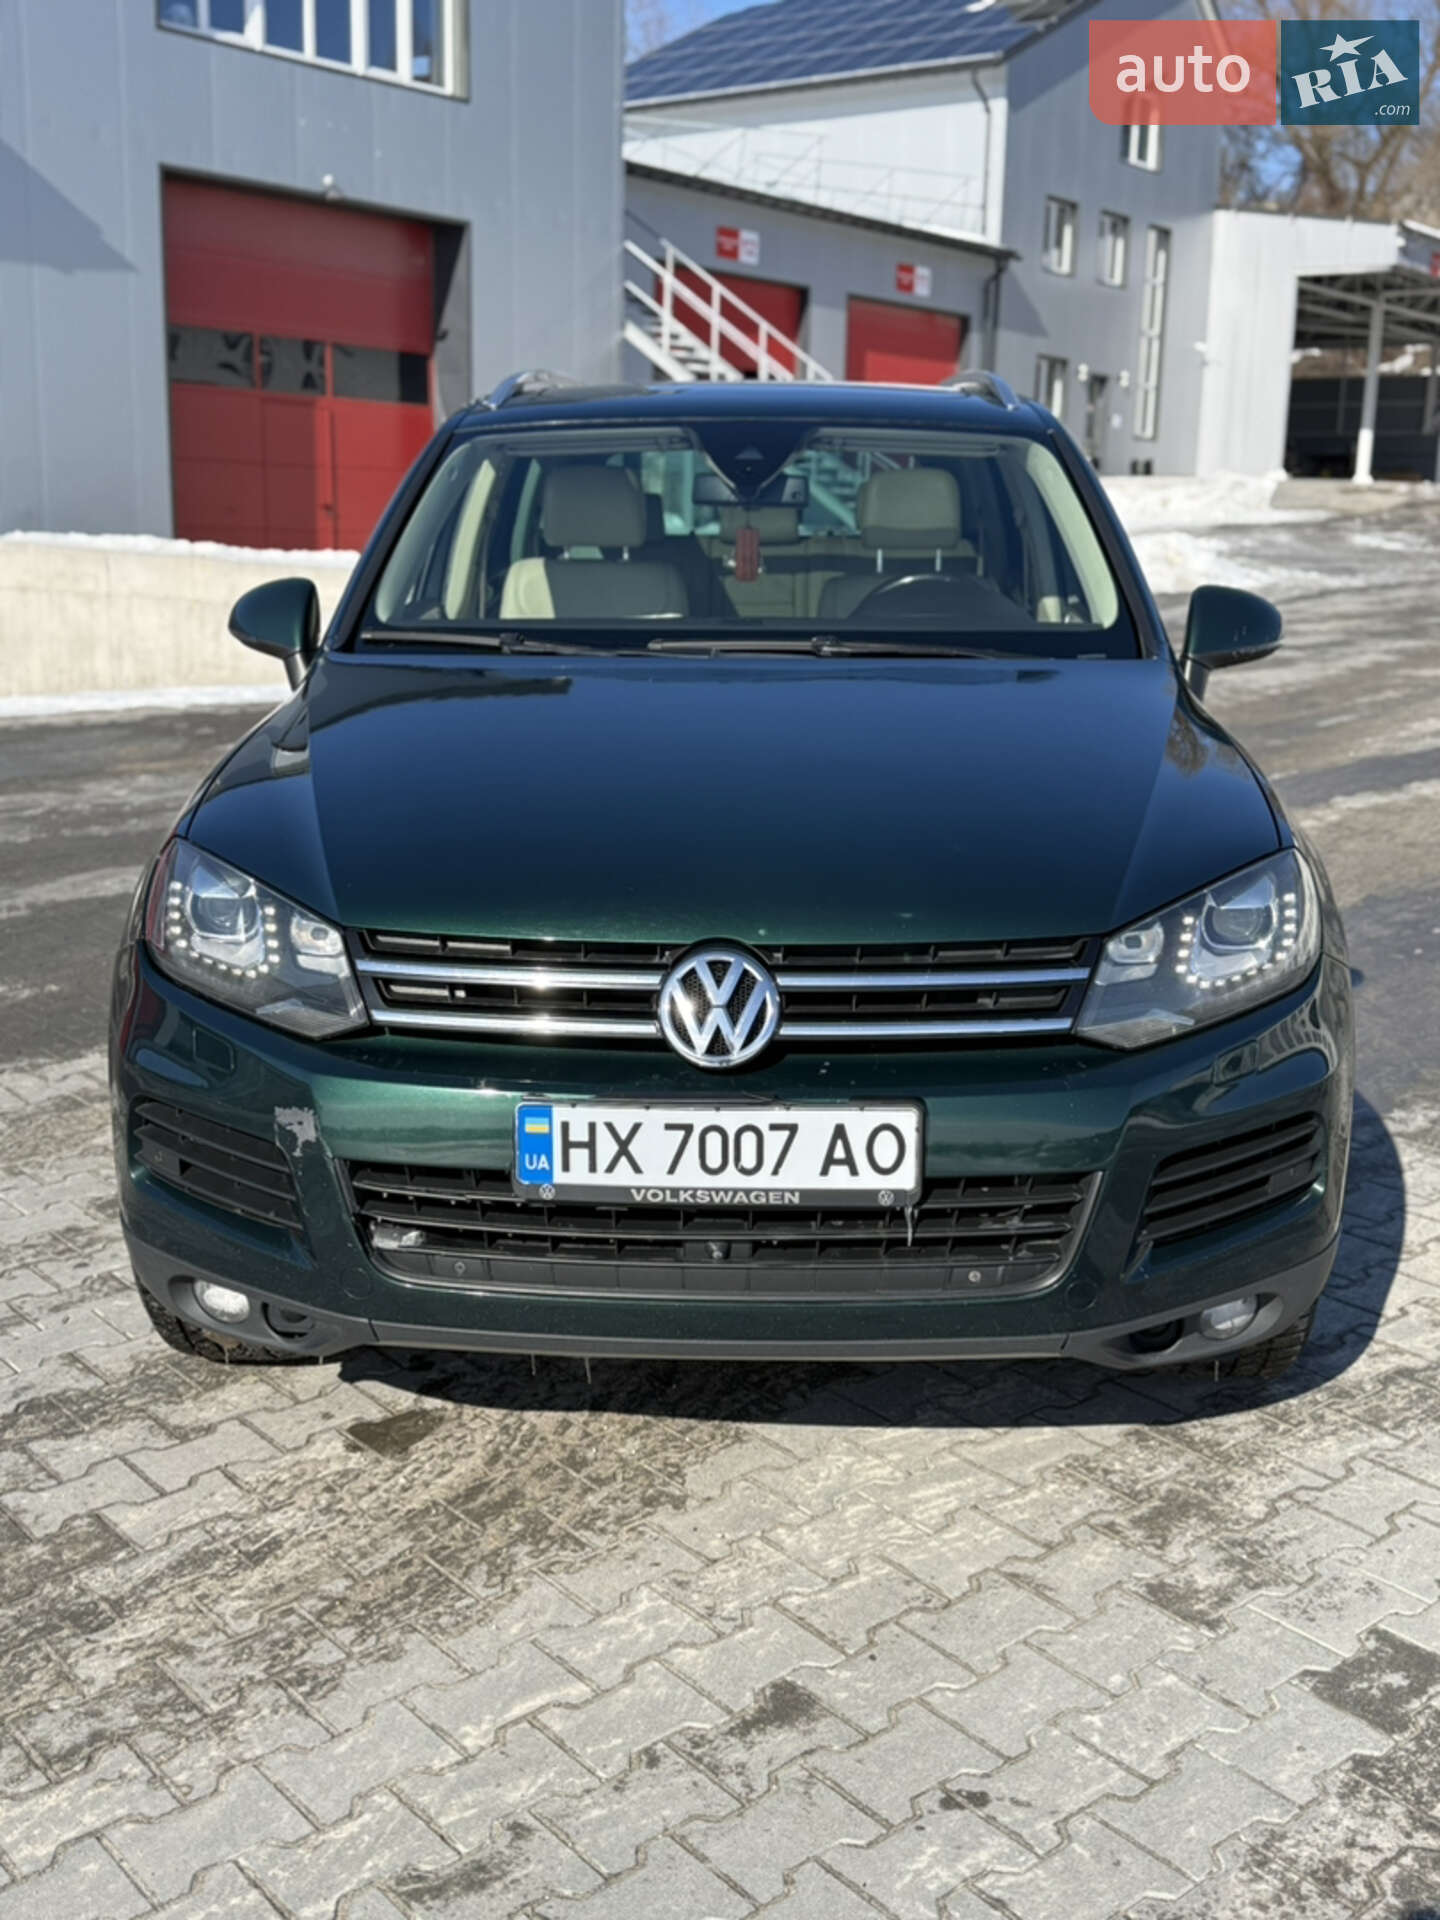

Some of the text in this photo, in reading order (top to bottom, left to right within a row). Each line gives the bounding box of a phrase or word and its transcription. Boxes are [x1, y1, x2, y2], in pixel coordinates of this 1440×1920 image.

[560, 1121, 907, 1177] HX 7007 AO
[525, 1153, 551, 1171] UA
[631, 1187, 801, 1205] VOLKSWAGEN
